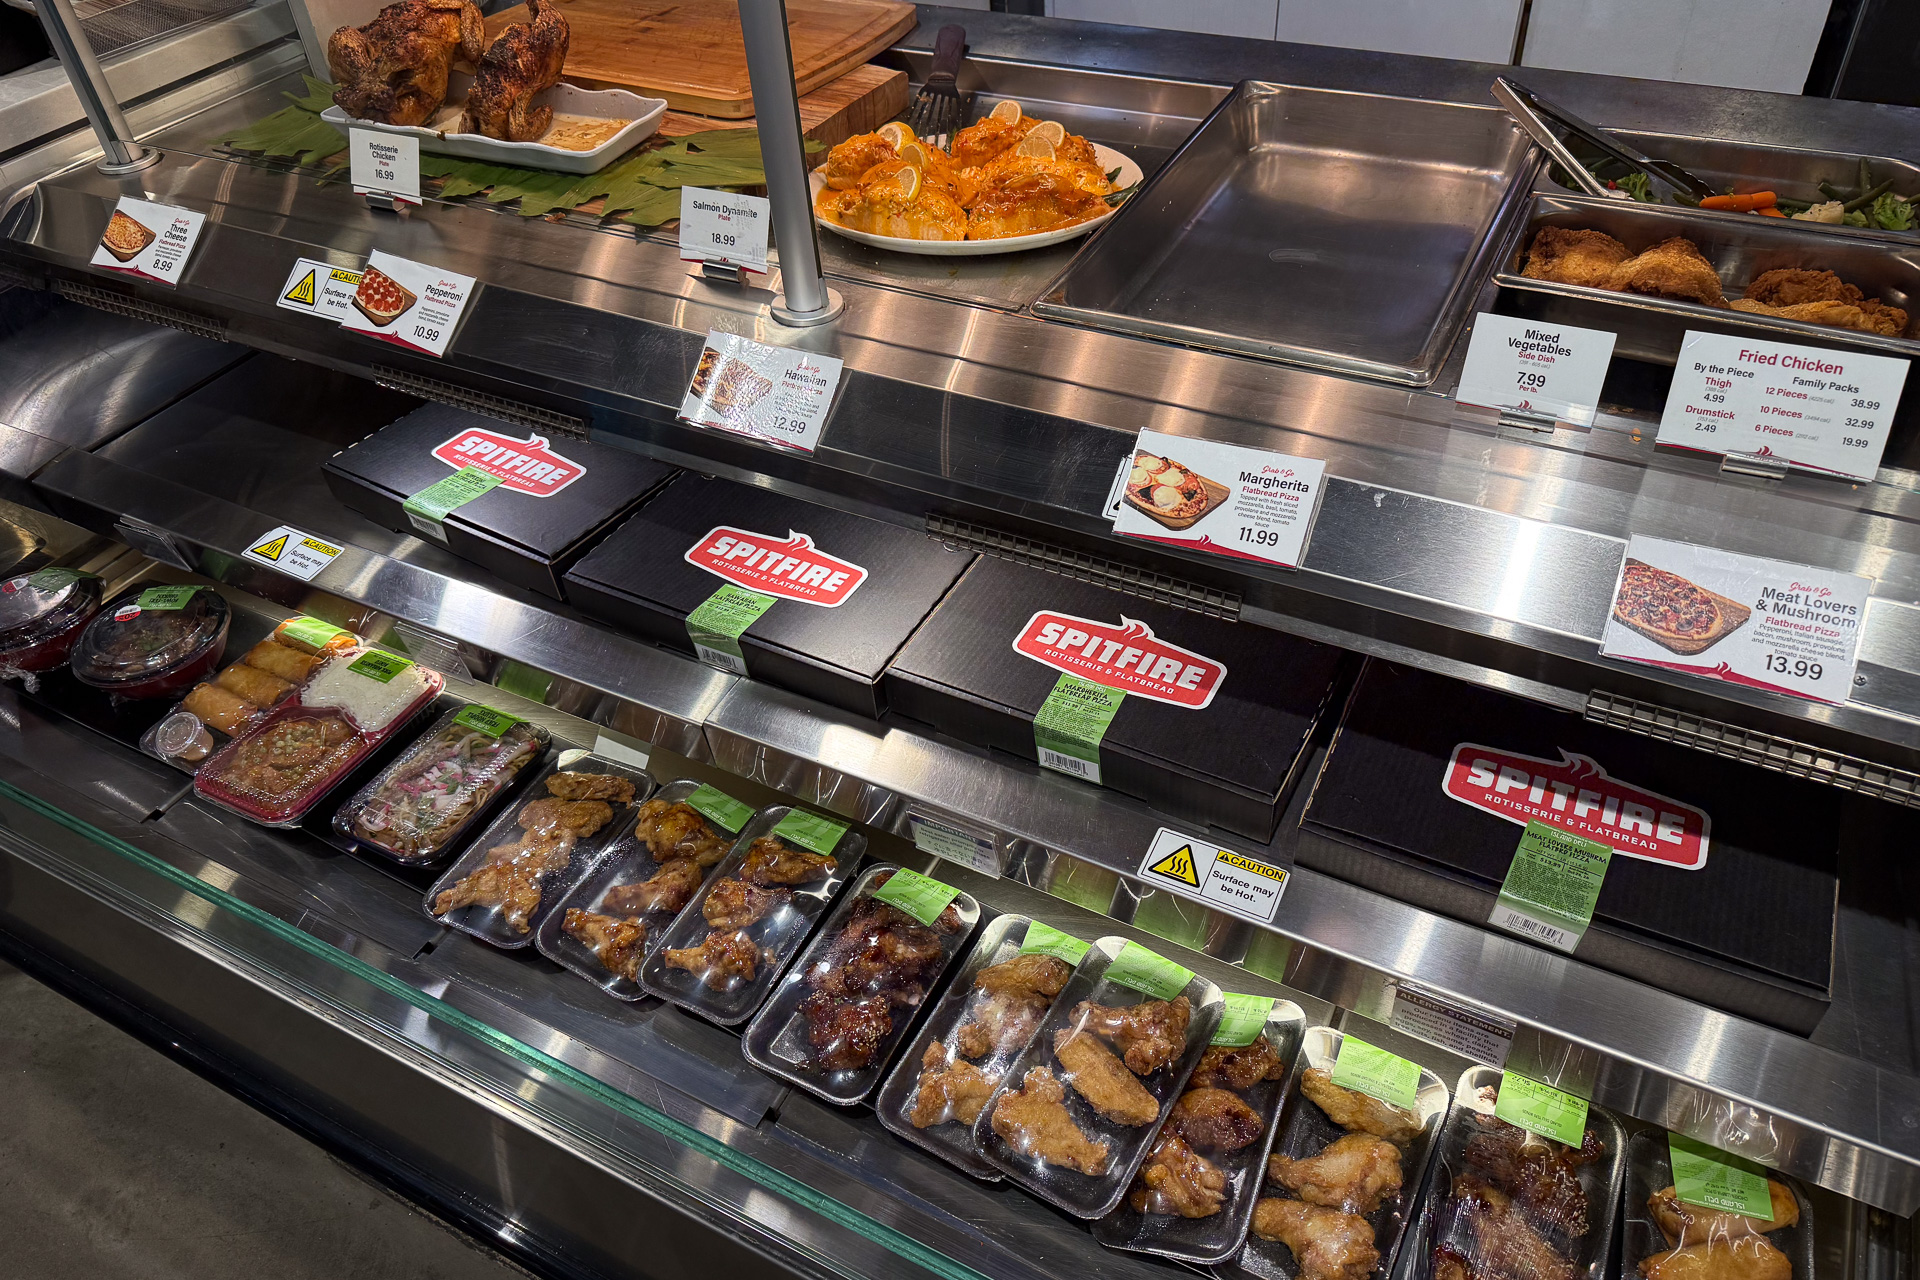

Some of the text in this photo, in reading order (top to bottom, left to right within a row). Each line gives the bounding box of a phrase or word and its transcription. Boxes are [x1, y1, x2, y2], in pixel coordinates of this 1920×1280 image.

[369, 142, 398, 154] Rotisserie
[372, 151, 396, 161] Chicken
[375, 169, 394, 180] 16.99
[693, 201, 758, 218] Salmon Dynamite
[164, 230, 187, 242] Cheese
[171, 224, 188, 234] Three
[712, 233, 735, 246] 18.99
[153, 259, 172, 271] 8.99
[324, 288, 346, 299] Surface
[425, 284, 463, 301] Pepperoni
[335, 301, 348, 309] Hot.
[424, 295, 456, 308] Flatbread Pizza
[413, 325, 439, 341] 10.99
[1525, 329, 1560, 343] Mixed
[1509, 337, 1572, 356] Vegetables
[1518, 351, 1555, 363] Side Dish
[1739, 350, 1844, 375] Fried Chicken
[785, 369, 827, 386] Hawaiian
[1694, 362, 1754, 378] By the Piece
[1517, 372, 1546, 387] 7.99
[1705, 376, 1732, 389] Thigh
[1792, 376, 1860, 394] Family Packs
[1704, 393, 1724, 403] 4.99
[1765, 387, 1808, 400] 12 Pieces
[1686, 405, 1735, 419] Drumstick
[1760, 406, 1802, 419] 10 Pieces
[1850, 399, 1880, 410] 38.99
[773, 416, 806, 434] 12.99
[1695, 422, 1716, 432] 2.49
[1755, 424, 1794, 437] 6 Pieces
[1845, 418, 1874, 430] 32.99
[1842, 437, 1868, 448] 19.99
[453, 436, 570, 486] SPITFIRE
[454, 454, 492, 472] ROTISSERIE
[496, 471, 535, 488] FLATBREAD
[1239, 471, 1309, 493] Margherita
[1240, 494, 1258, 502] Topped
[1242, 486, 1300, 502] Flatbread Pizza
[1234, 506, 1258, 514] provolone
[1270, 512, 1297, 520] mozzarella
[1240, 527, 1279, 547] 11.99
[291, 550, 311, 561] Surface
[309, 542, 341, 556] CAUTION
[298, 562, 309, 570] Hot.
[706, 536, 850, 592] SPITFIRE
[712, 559, 760, 579] ROTISSERIE
[768, 577, 817, 596] FLATBREAD
[1762, 587, 1857, 615] Meat Lovers
[1756, 599, 1856, 628] & Mushroom
[1760, 624, 1793, 636] Pepperoni,
[1794, 631, 1815, 640] Italian
[1765, 616, 1840, 638] Flatbread Pizza
[1754, 630, 1846, 654] bacon, mushroom, provolone
[1765, 640, 1799, 651] mozzarella
[1800, 647, 1824, 656] cheese
[1035, 622, 1206, 690] SPITFIRE
[1774, 649, 1818, 662] tomato sauce
[1044, 649, 1102, 672] ROTISSERIE
[1115, 672, 1175, 694] FLATBREAD
[1766, 654, 1823, 680] 13.99
[1054, 687, 1112, 707] FLATBREAD PIZZA
[1065, 683, 1108, 699] MARGHERITA
[1467, 758, 1686, 845] SPITFIRE
[1484, 793, 1561, 823] ROTISSERIE
[1566, 818, 1574, 826] &
[1579, 821, 1658, 850] FLATBREAD
[923, 819, 976, 842] IMPORTANT
[1551, 831, 1587, 847] ISLAND DELI
[1527, 831, 1547, 842] MEAT
[1548, 838, 1573, 851] LOVERS
[1574, 847, 1607, 864] MUSHRM
[1539, 841, 1590, 864] FLATBRD PIZZA
[1228, 857, 1284, 880] CAUTION
[1212, 870, 1275, 897] Surface may
[1220, 884, 1256, 903] be Hot.
[1124, 977, 1155, 992] ISLAND DELI
[1400, 992, 1445, 1013] ALLERGY
[1401, 1006, 1437, 1025] produced
[1455, 1027, 1481, 1042] facility
[1483, 1038, 1499, 1048] that
[1413, 1006, 1489, 1039] Our menu items are
[1395, 1015, 1499, 1060] eggs, soy, sesame, peanuts,
[1404, 1013, 1493, 1052] processes wheat, dairy,
[1394, 1020, 1497, 1065] tree nuts, fish, and shellfish
[1355, 1080, 1390, 1097] ISLAND DELI
[1519, 1118, 1556, 1135] ISLAND DELI
[1704, 1196, 1720, 1204] DELI
[1721, 1199, 1745, 1210] ISLAND
